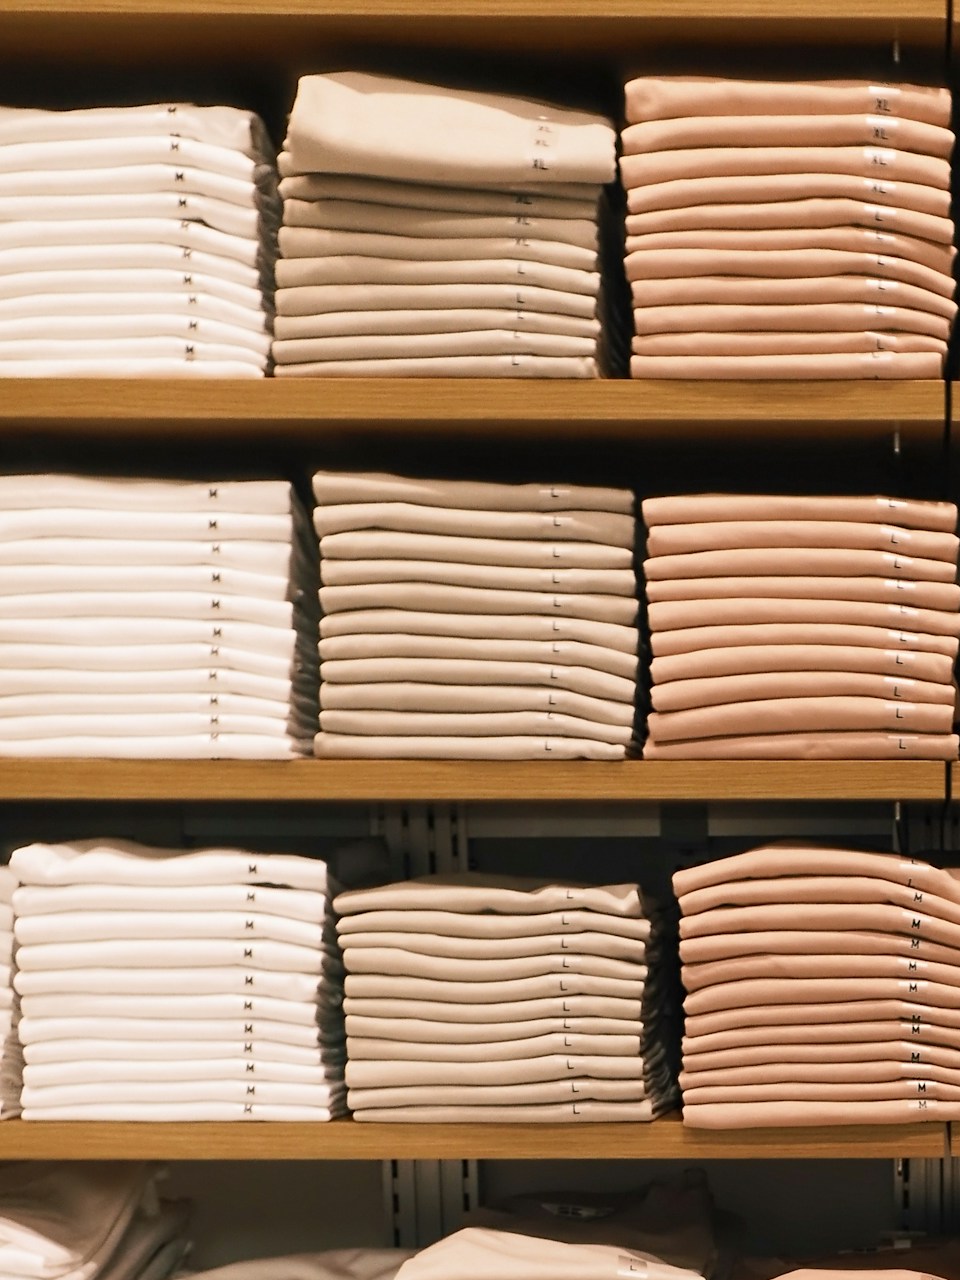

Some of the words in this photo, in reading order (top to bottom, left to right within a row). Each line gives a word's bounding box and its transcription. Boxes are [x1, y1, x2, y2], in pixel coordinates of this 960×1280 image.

[249, 865, 256, 874] M
[914, 893, 922, 902] M
[562, 916, 569, 925] L
[912, 919, 920, 929] M
[244, 949, 252, 958] M
[560, 981, 567, 991] L
[909, 983, 917, 992] M
[563, 1001, 570, 1011] L
[245, 1024, 252, 1033] M
[912, 1025, 920, 1034] M
[247, 1086, 255, 1095] M
[572, 1083, 579, 1092] L
[918, 1083, 926, 1092] M
[573, 1105, 580, 1114] L
